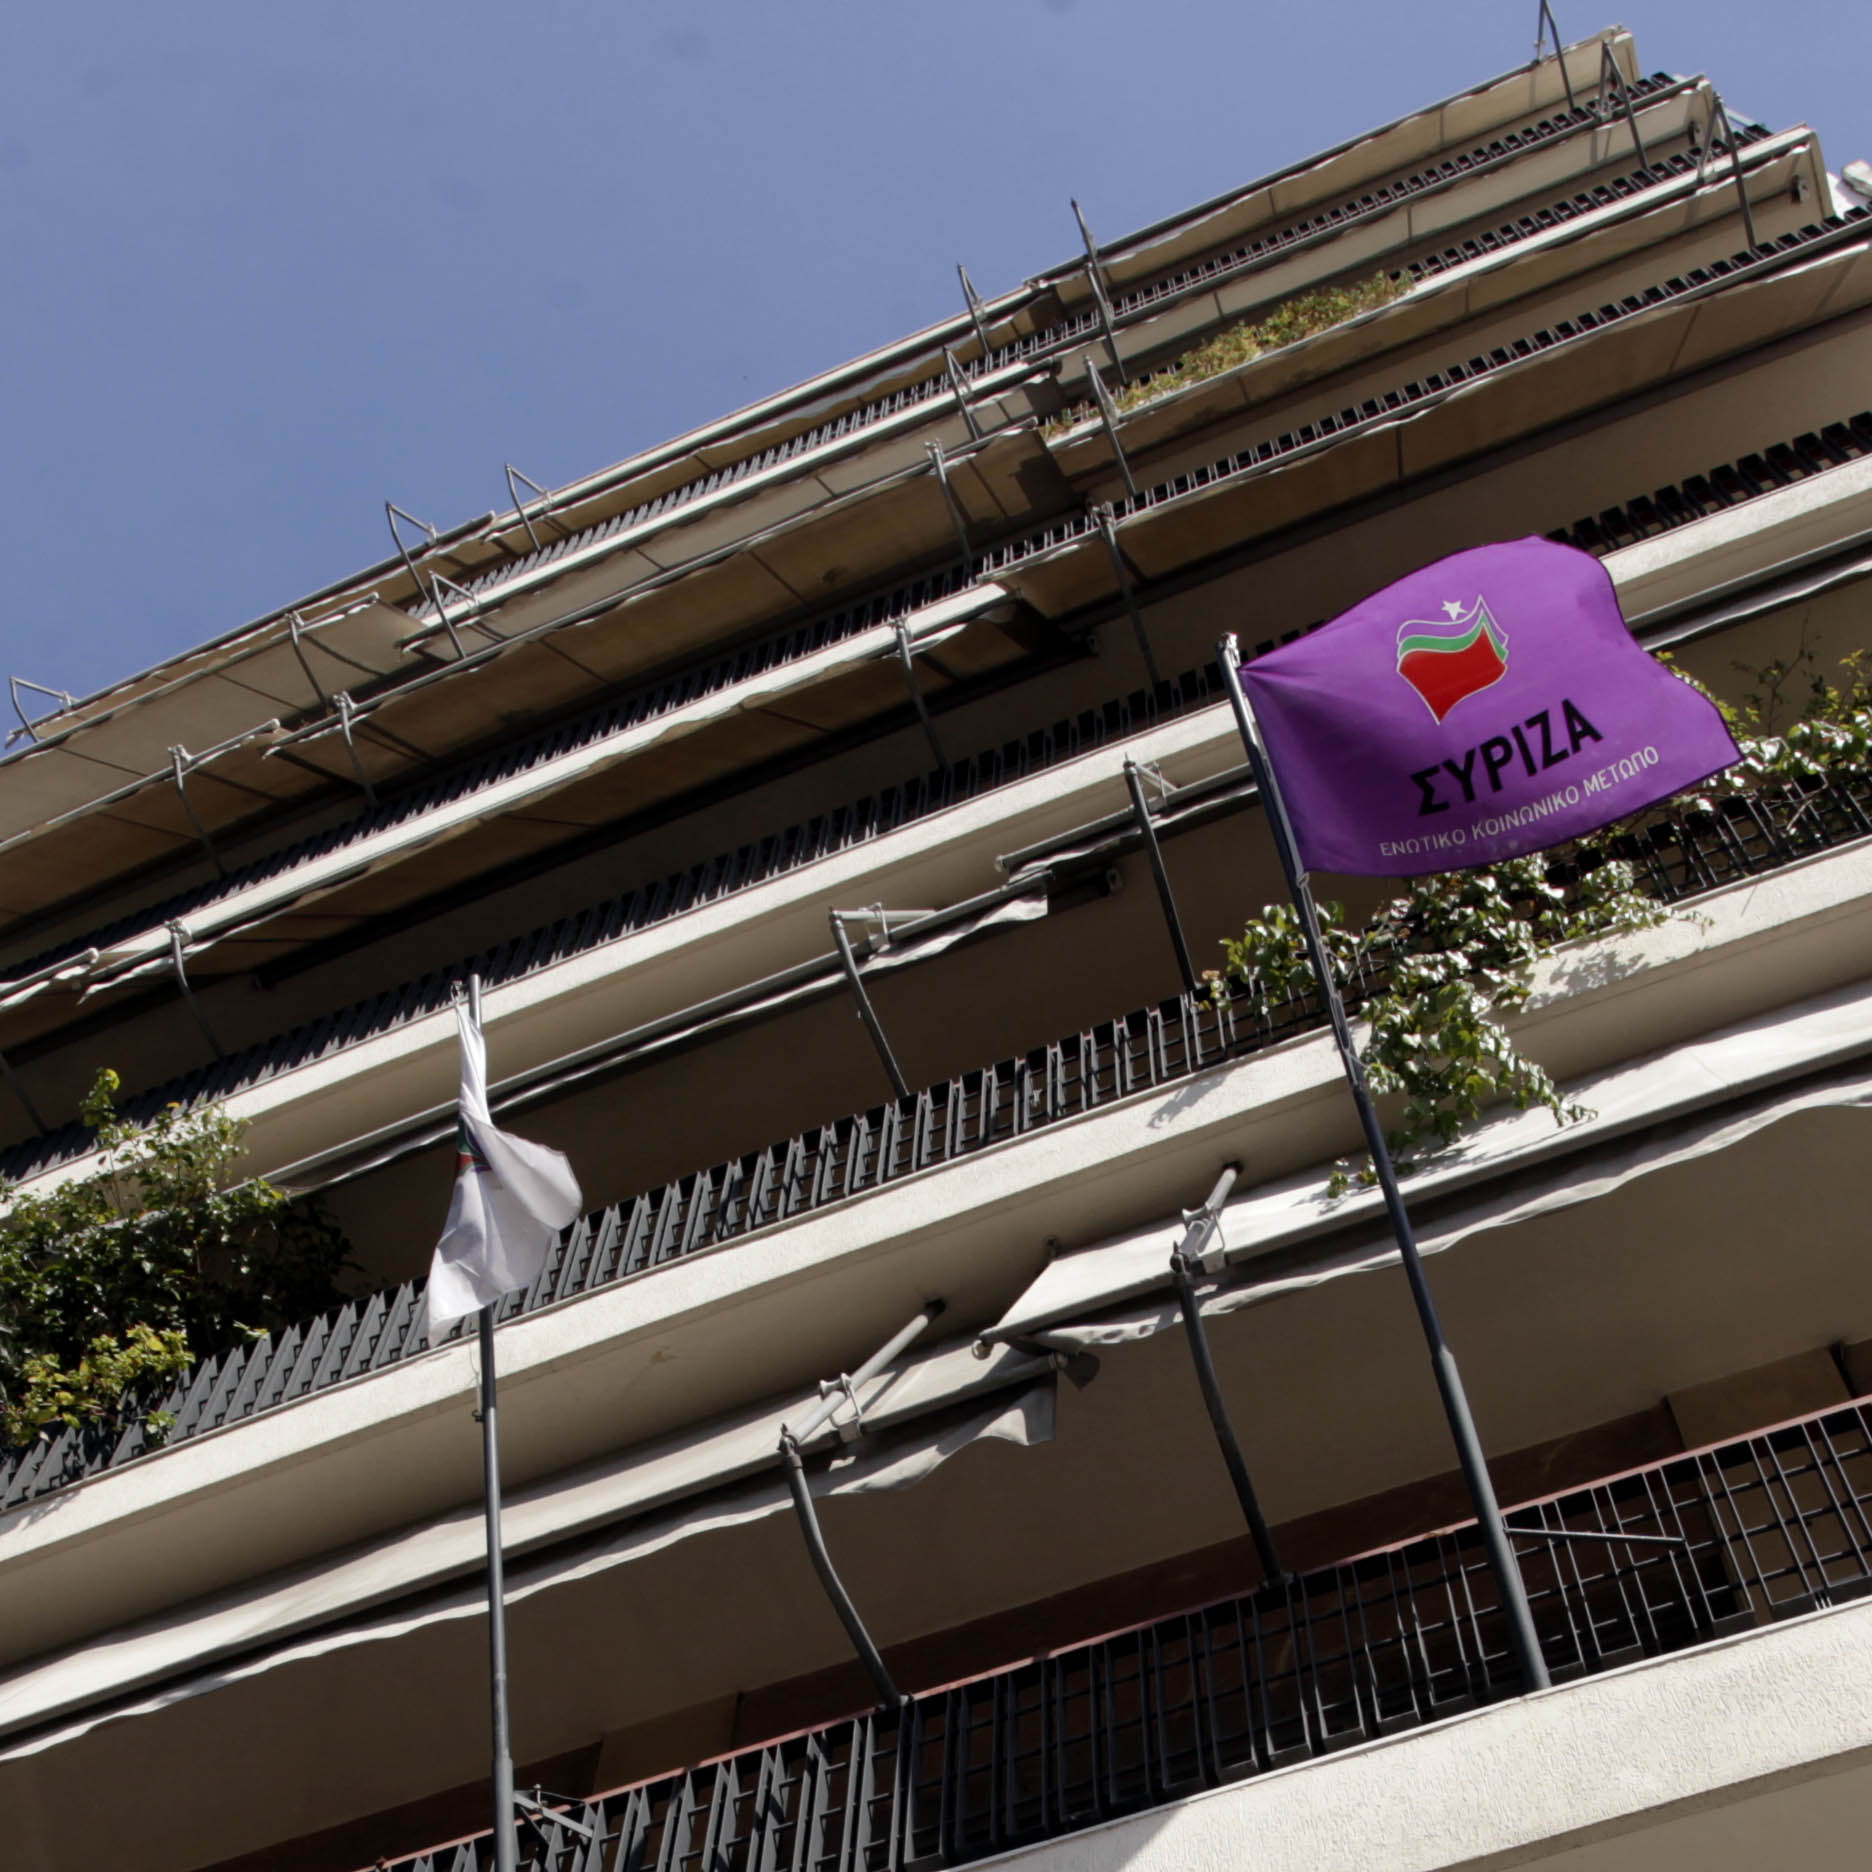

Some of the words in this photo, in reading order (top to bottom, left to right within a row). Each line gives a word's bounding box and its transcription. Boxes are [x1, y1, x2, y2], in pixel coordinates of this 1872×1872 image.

[1379, 828, 1466, 857] ΕΝΩΤΙΚΟ
[1472, 786, 1580, 838] ΚΟΙΝΩΝΙΚΟ
[1584, 745, 1660, 799] ΜΕΤΩΠΟ
[1409, 698, 1604, 817] ΣΥΡΙΖΑ
